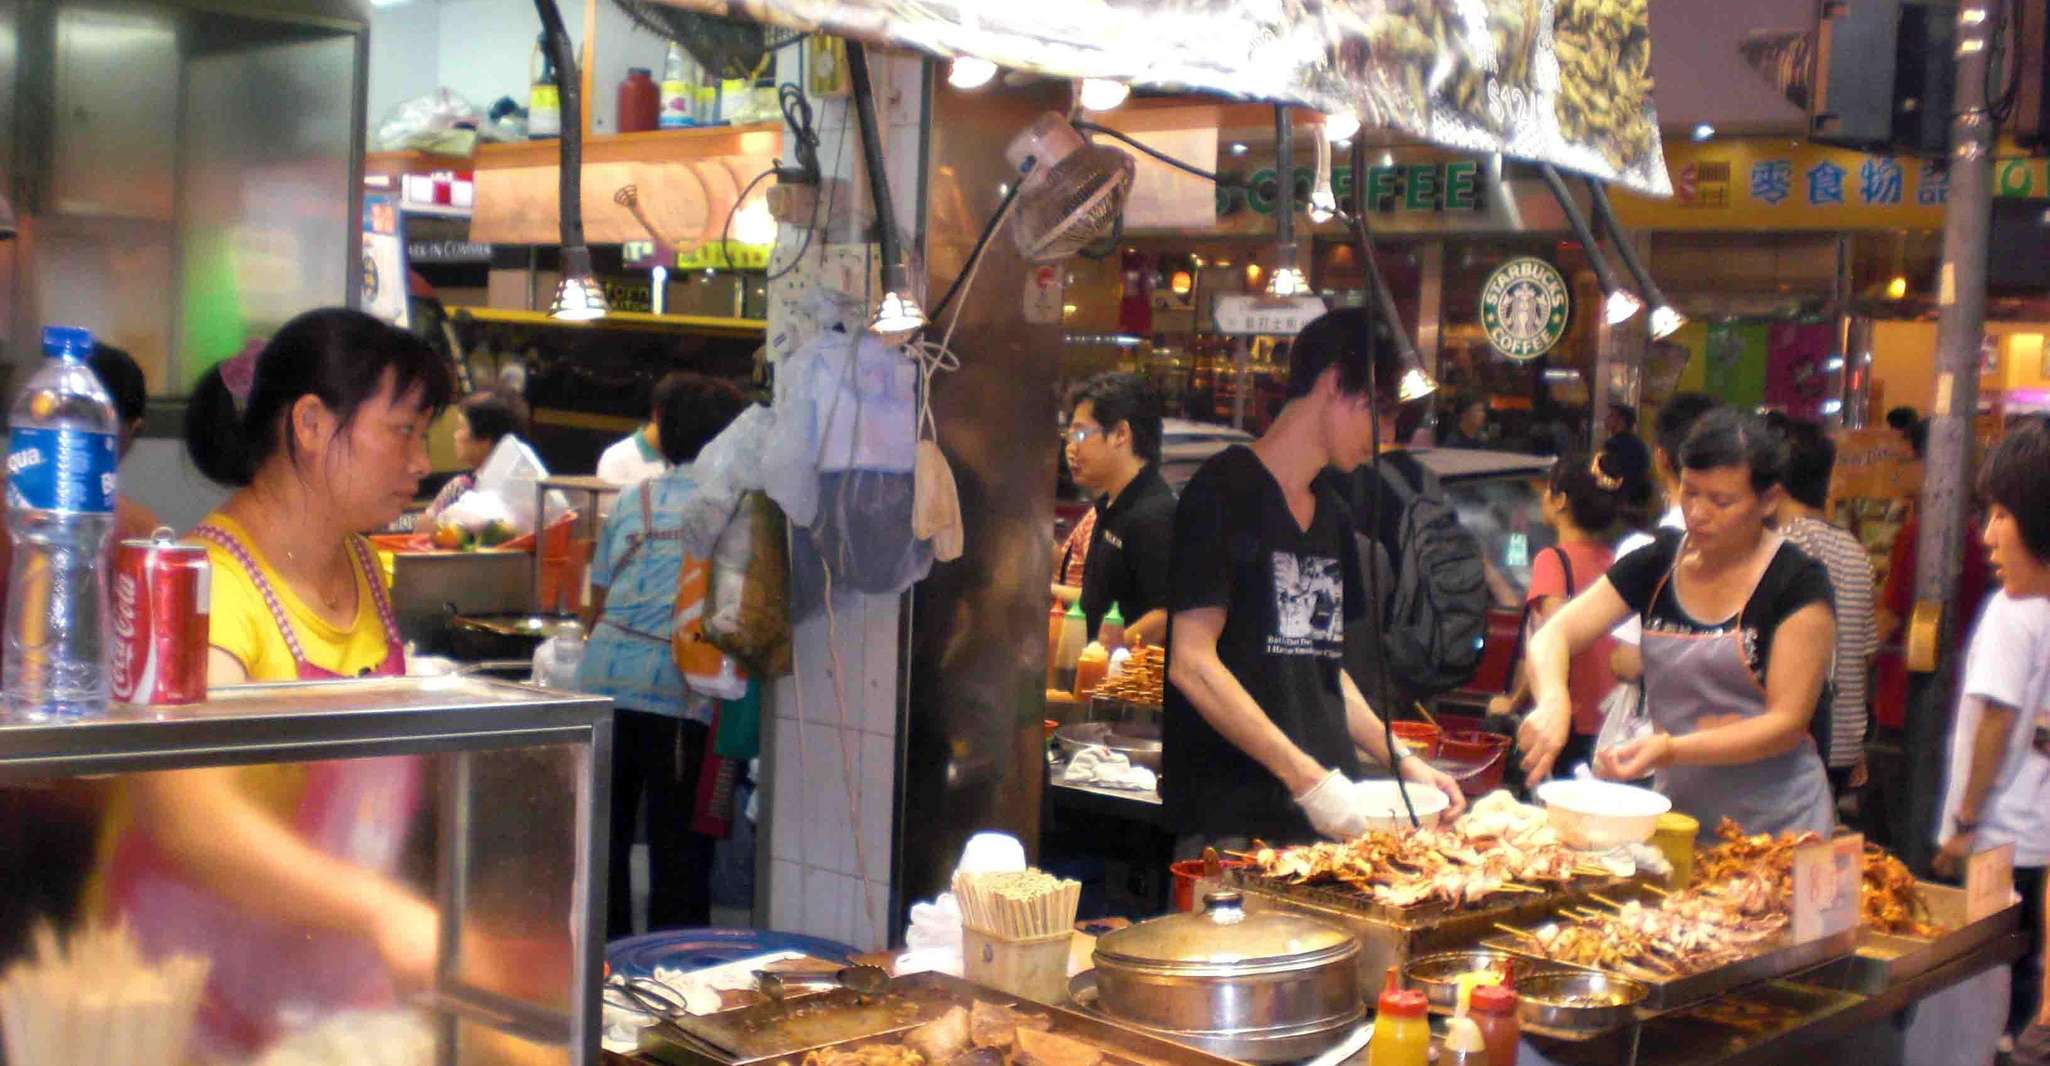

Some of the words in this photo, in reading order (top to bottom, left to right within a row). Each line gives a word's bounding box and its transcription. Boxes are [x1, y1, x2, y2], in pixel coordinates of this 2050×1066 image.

[1485, 262, 1566, 308] STARBUCKS
[1492, 327, 1553, 354] COFFEE
[7, 447, 42, 475] qua
